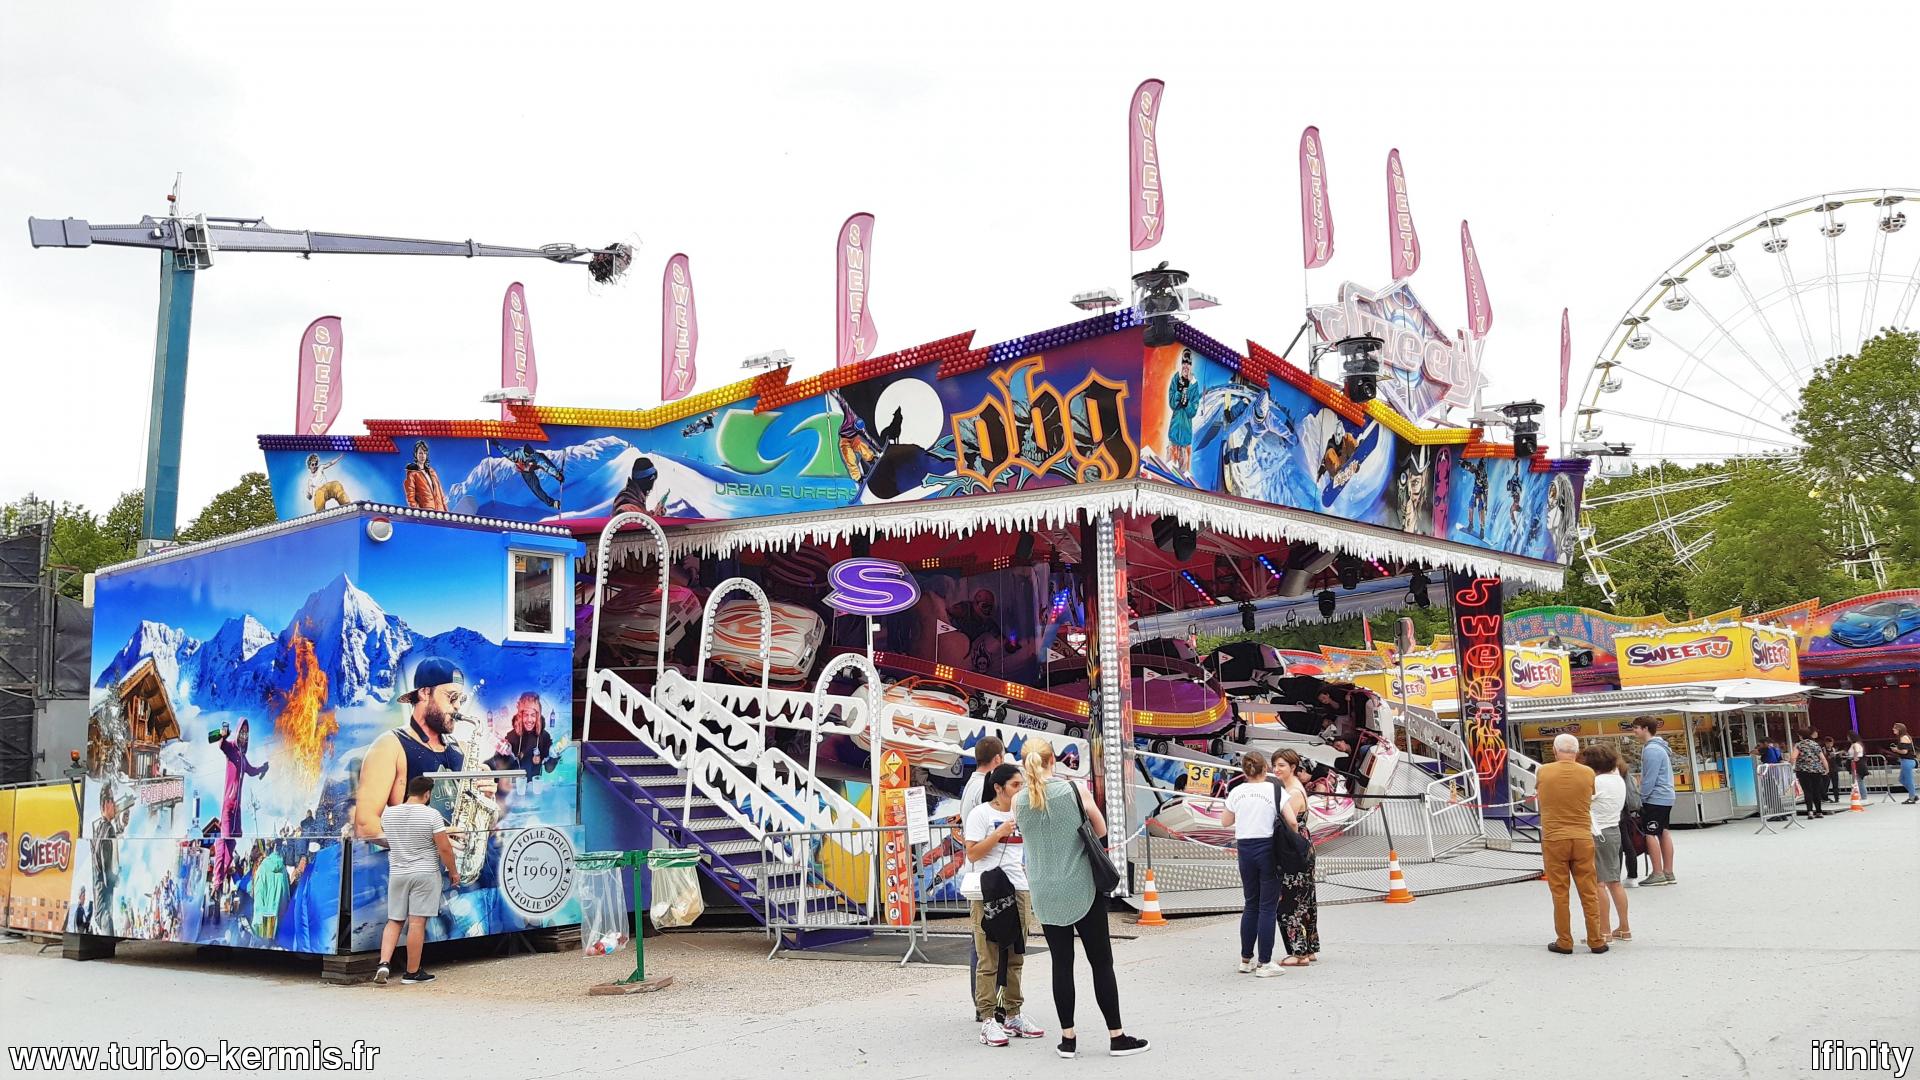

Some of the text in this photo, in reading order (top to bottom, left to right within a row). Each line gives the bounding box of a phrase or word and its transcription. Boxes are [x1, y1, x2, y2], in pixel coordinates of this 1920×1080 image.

[1138, 91, 1159, 240] SWEETY
[1391, 157, 1415, 270] SWEETY
[846, 223, 865, 355] SWEETY
[510, 291, 526, 389] SWEET
[672, 263, 689, 392] SWEETY
[715, 481, 774, 497] URBAN
[1628, 638, 1730, 666] SWEETY
[1751, 635, 1791, 670] SWEETY
[1510, 655, 1561, 688] SWEETY
[19, 834, 71, 872] SWEETY
[507, 830, 571, 864] LA FOLIE DOUCE
[523, 861, 558, 881] 1969
[514, 892, 542, 910] FOLIE
[544, 877, 570, 908] DOUCE
